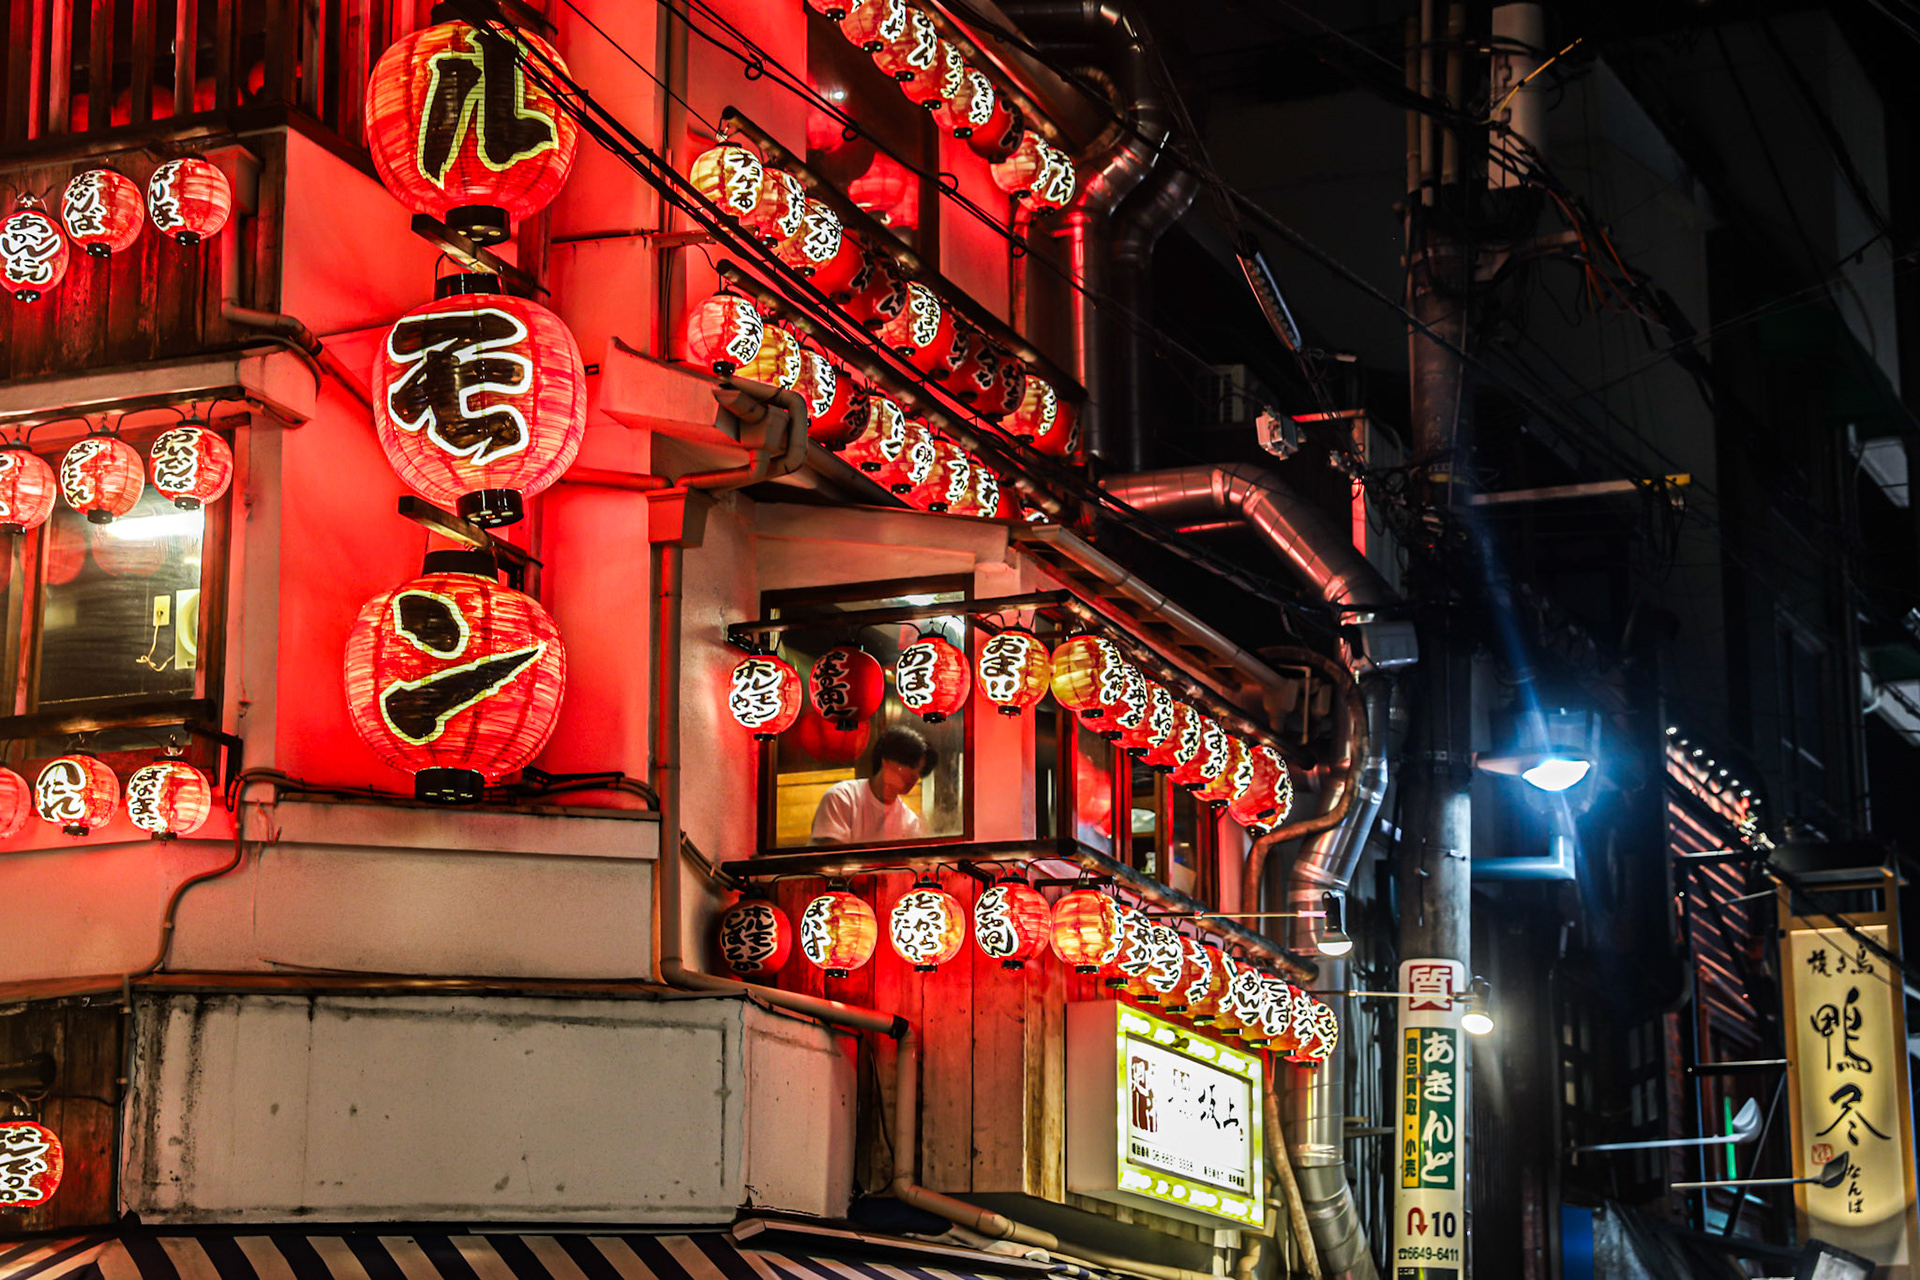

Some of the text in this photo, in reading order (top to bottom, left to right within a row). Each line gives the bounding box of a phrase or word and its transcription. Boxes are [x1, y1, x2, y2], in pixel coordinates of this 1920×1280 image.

[0, 213, 61, 284] あかんたれ
[36, 759, 87, 823] へたれ
[1409, 965, 1453, 1011] 質
[1419, 1031, 1455, 1184] あきんど
[1847, 1163, 1866, 1214] なんば
[1432, 1211, 1456, 1239] 10
